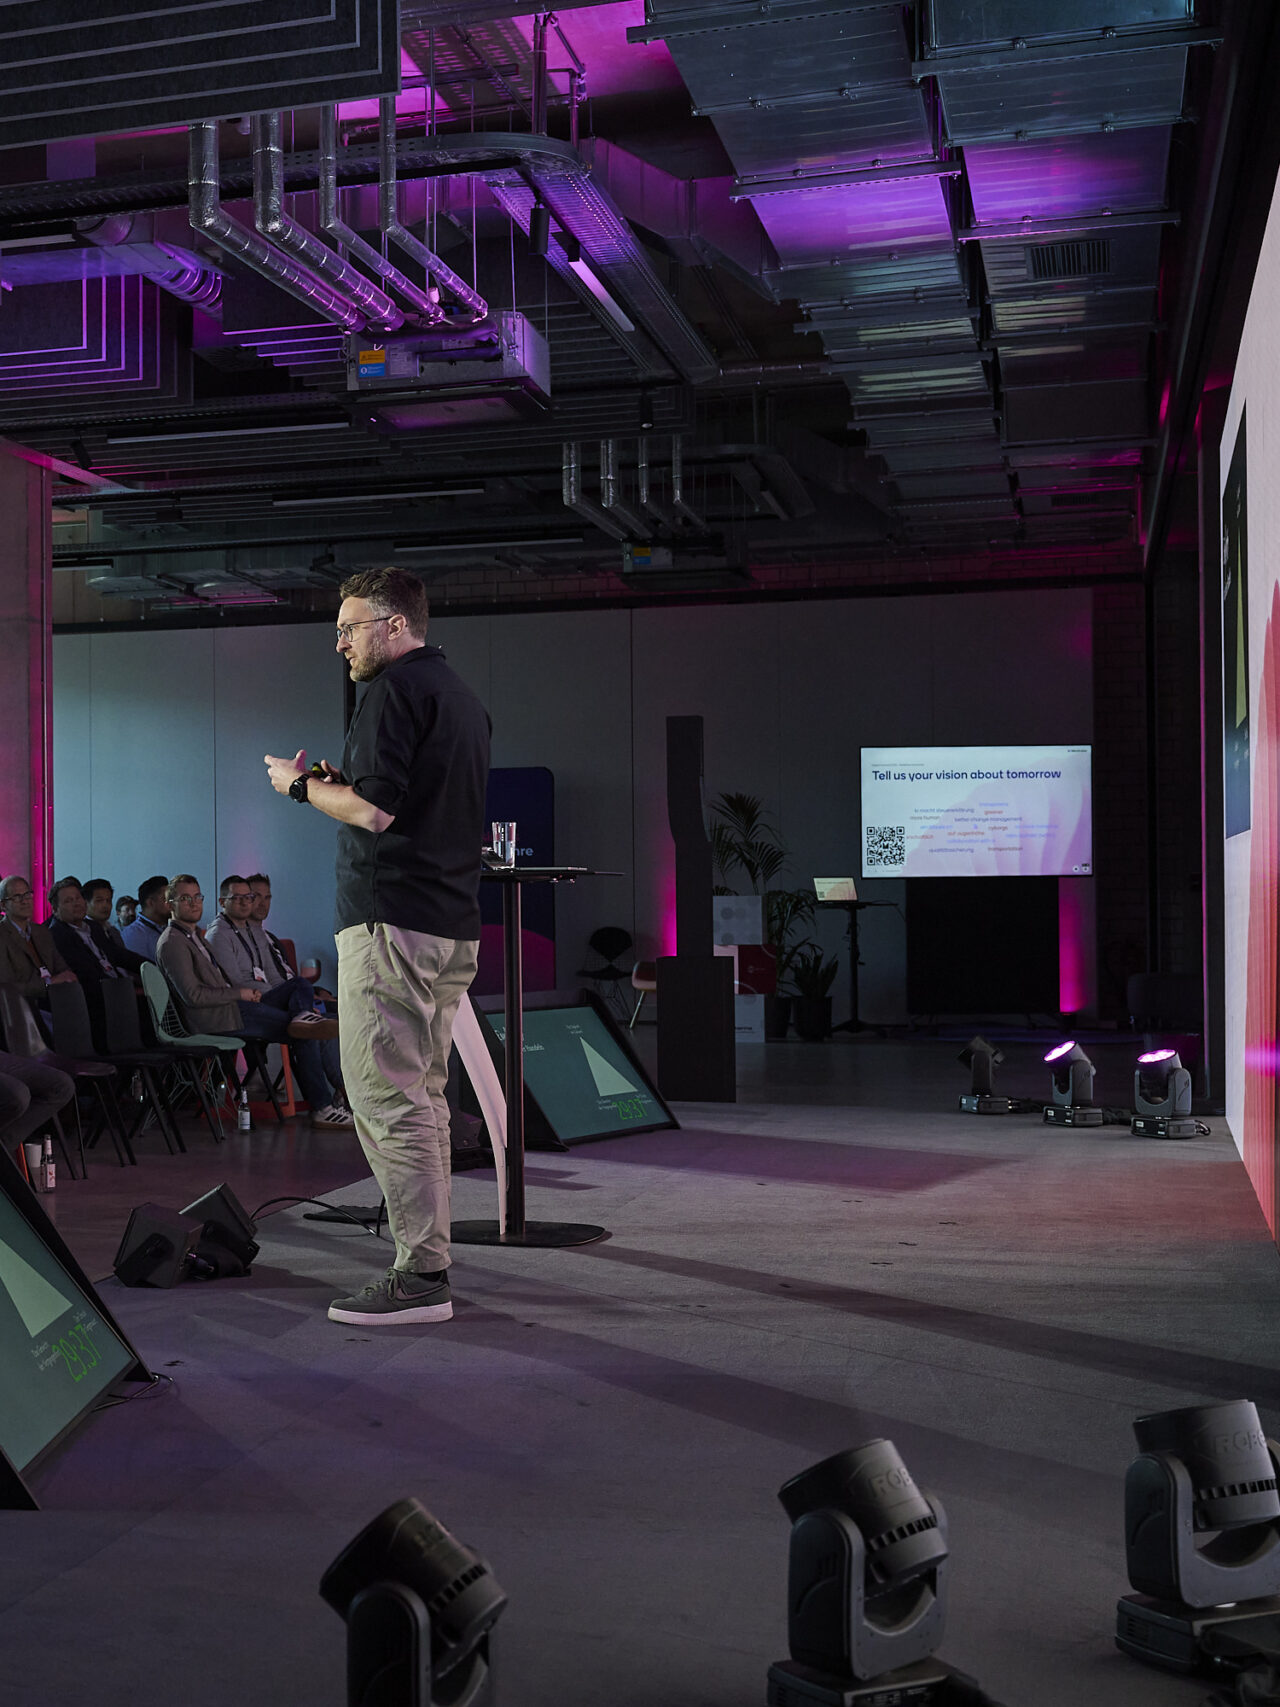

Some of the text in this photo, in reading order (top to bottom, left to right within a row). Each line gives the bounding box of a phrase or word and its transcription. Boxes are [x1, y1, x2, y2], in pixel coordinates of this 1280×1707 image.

[872, 769, 1061, 782] Tell us your vision about tomorrow
[51, 1323, 102, 1382] 29:37
